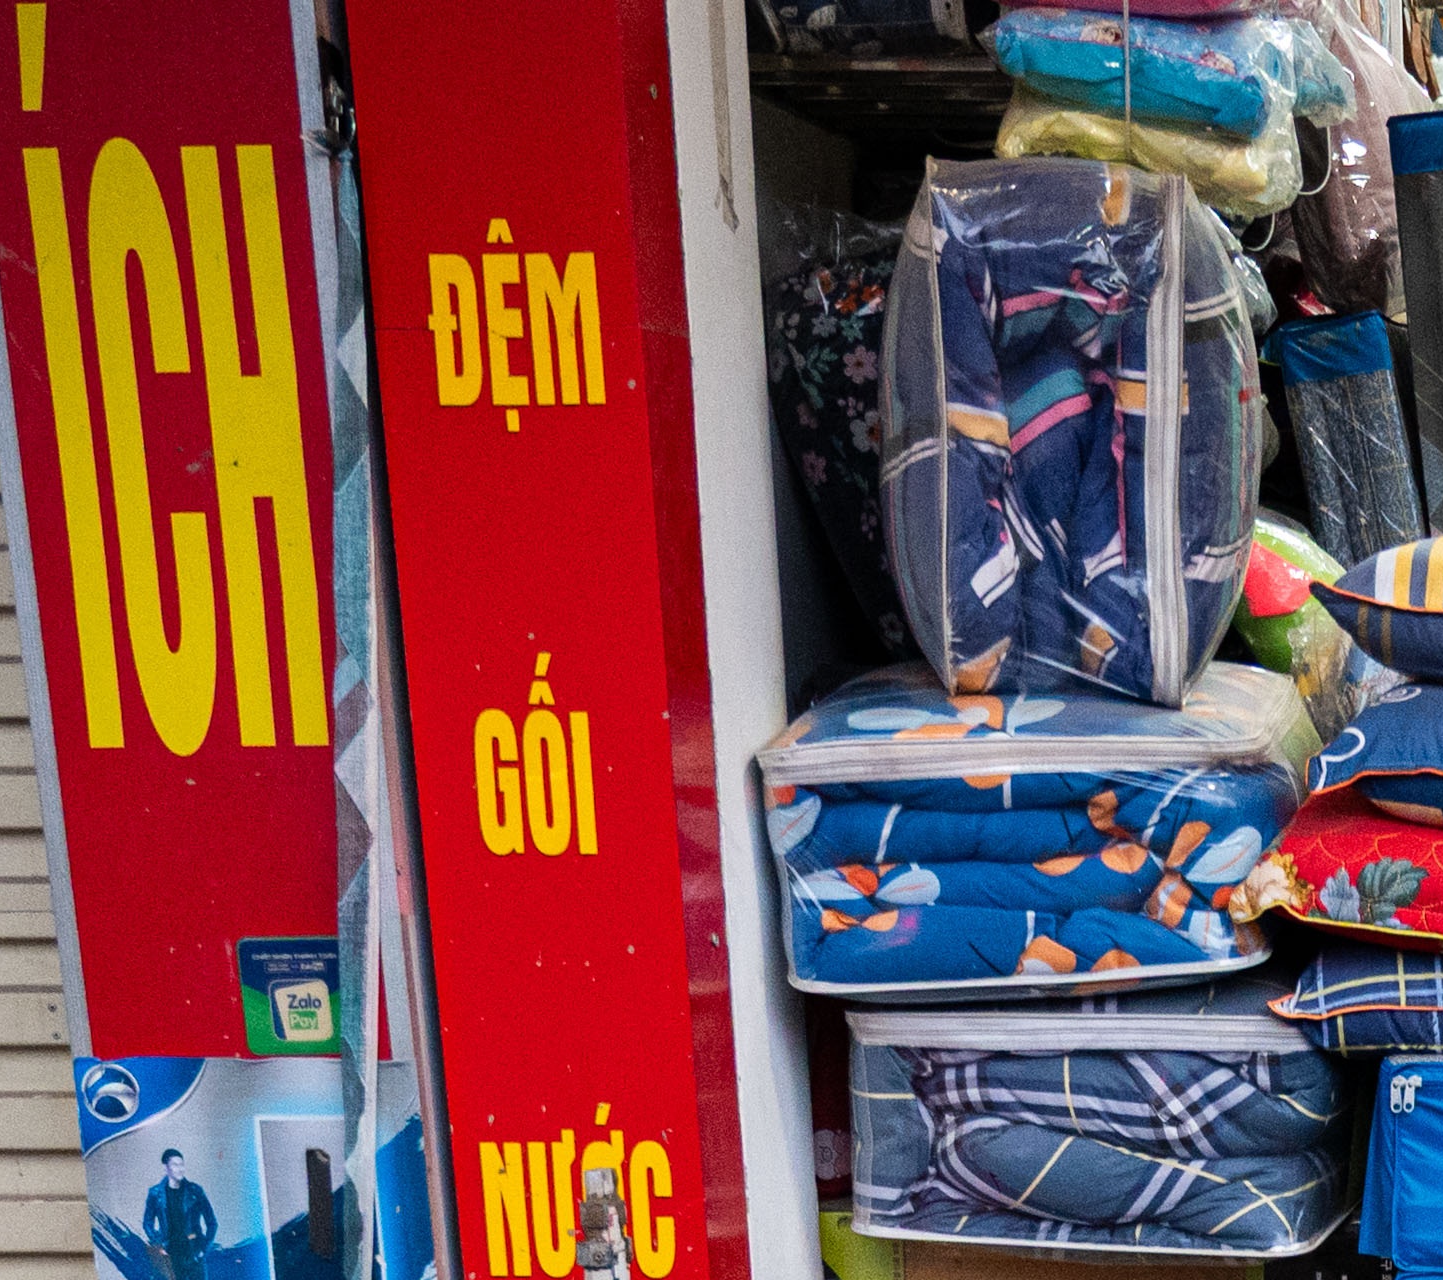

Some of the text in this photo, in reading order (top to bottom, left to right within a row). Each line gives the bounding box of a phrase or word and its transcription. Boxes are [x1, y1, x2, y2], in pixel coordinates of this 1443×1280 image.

[17, 3, 330, 757] ÍCH
[428, 218, 606, 433] ĐỆM
[474, 652, 599, 857] GỐI
[287, 992, 322, 1010] Zalo
[290, 1014, 316, 1030] Pay
